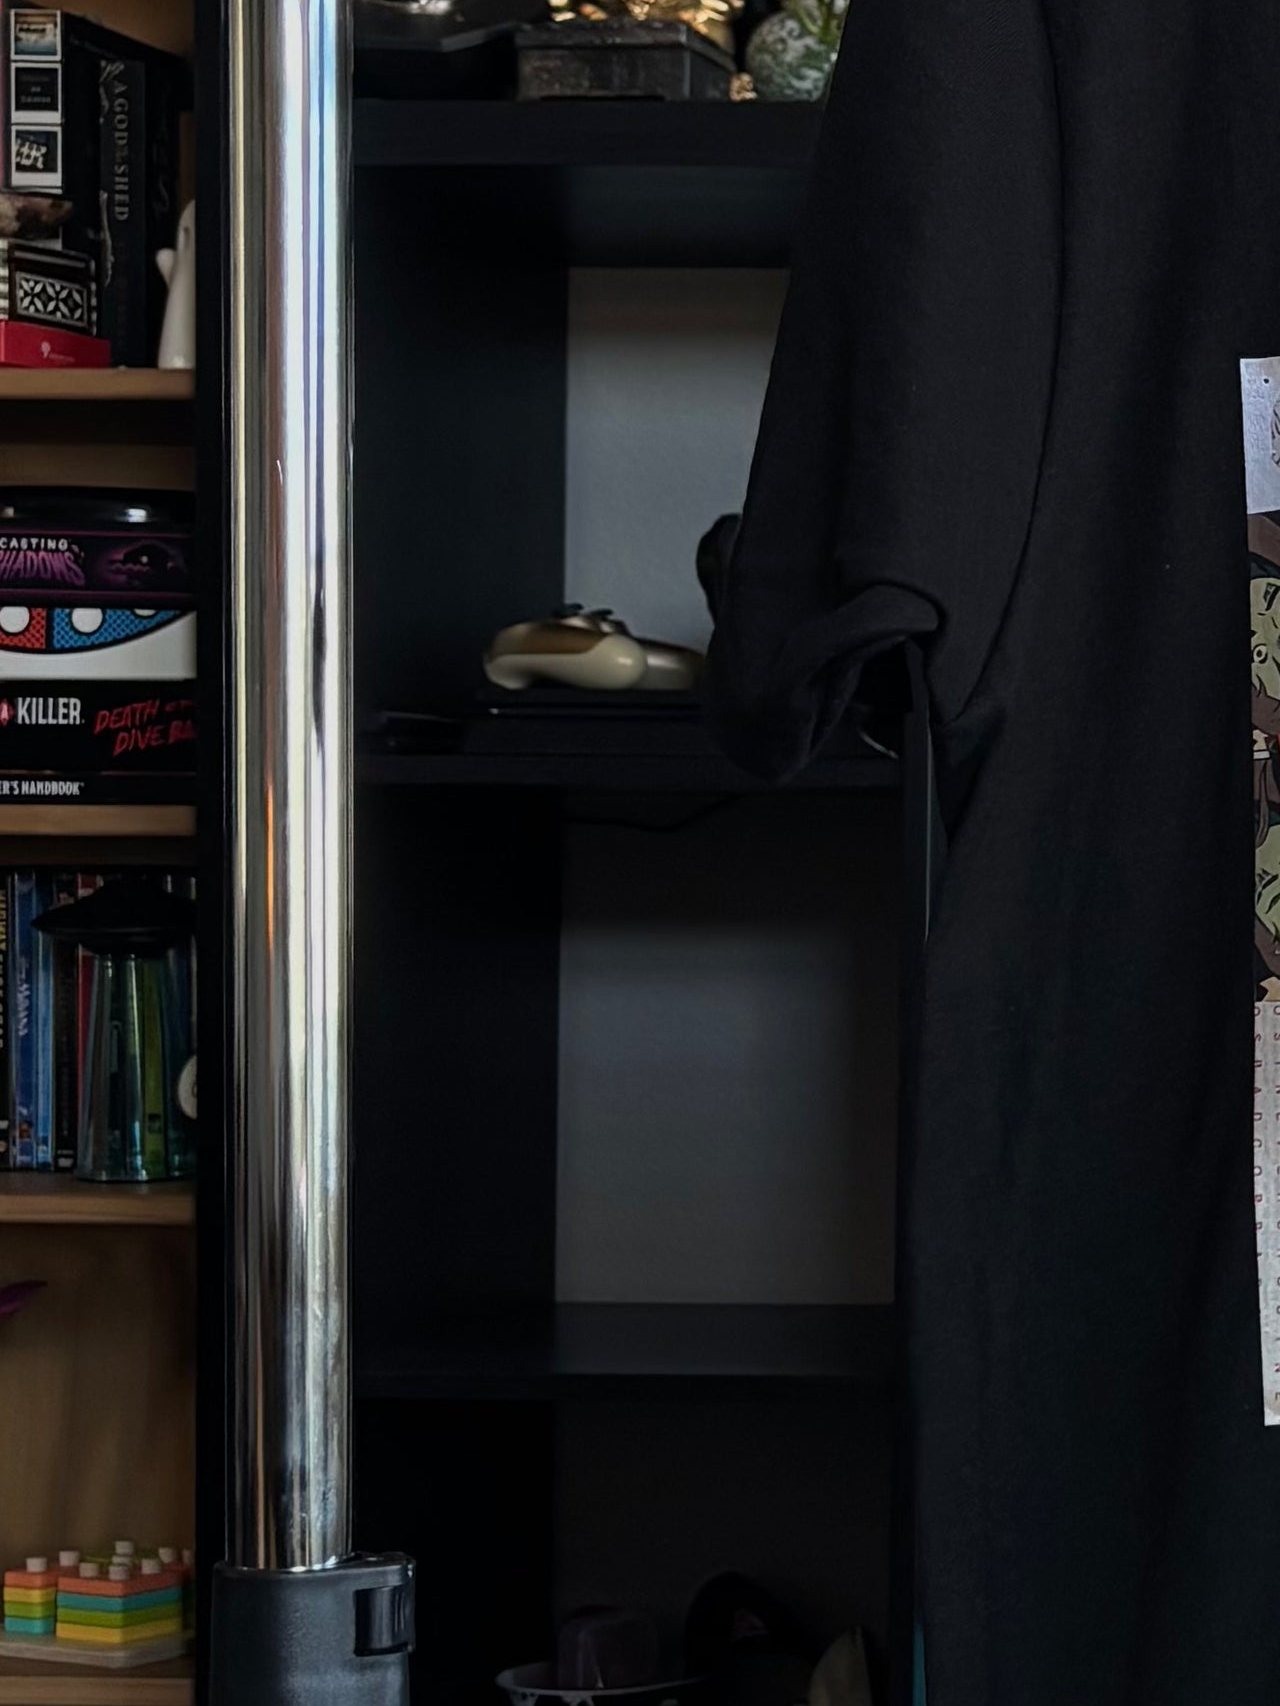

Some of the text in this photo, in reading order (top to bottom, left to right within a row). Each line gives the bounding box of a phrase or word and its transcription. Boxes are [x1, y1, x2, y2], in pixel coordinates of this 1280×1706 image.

[113, 97, 129, 146] GOD
[113, 163, 130, 222] SHED
[0, 537, 69, 551] CASTING
